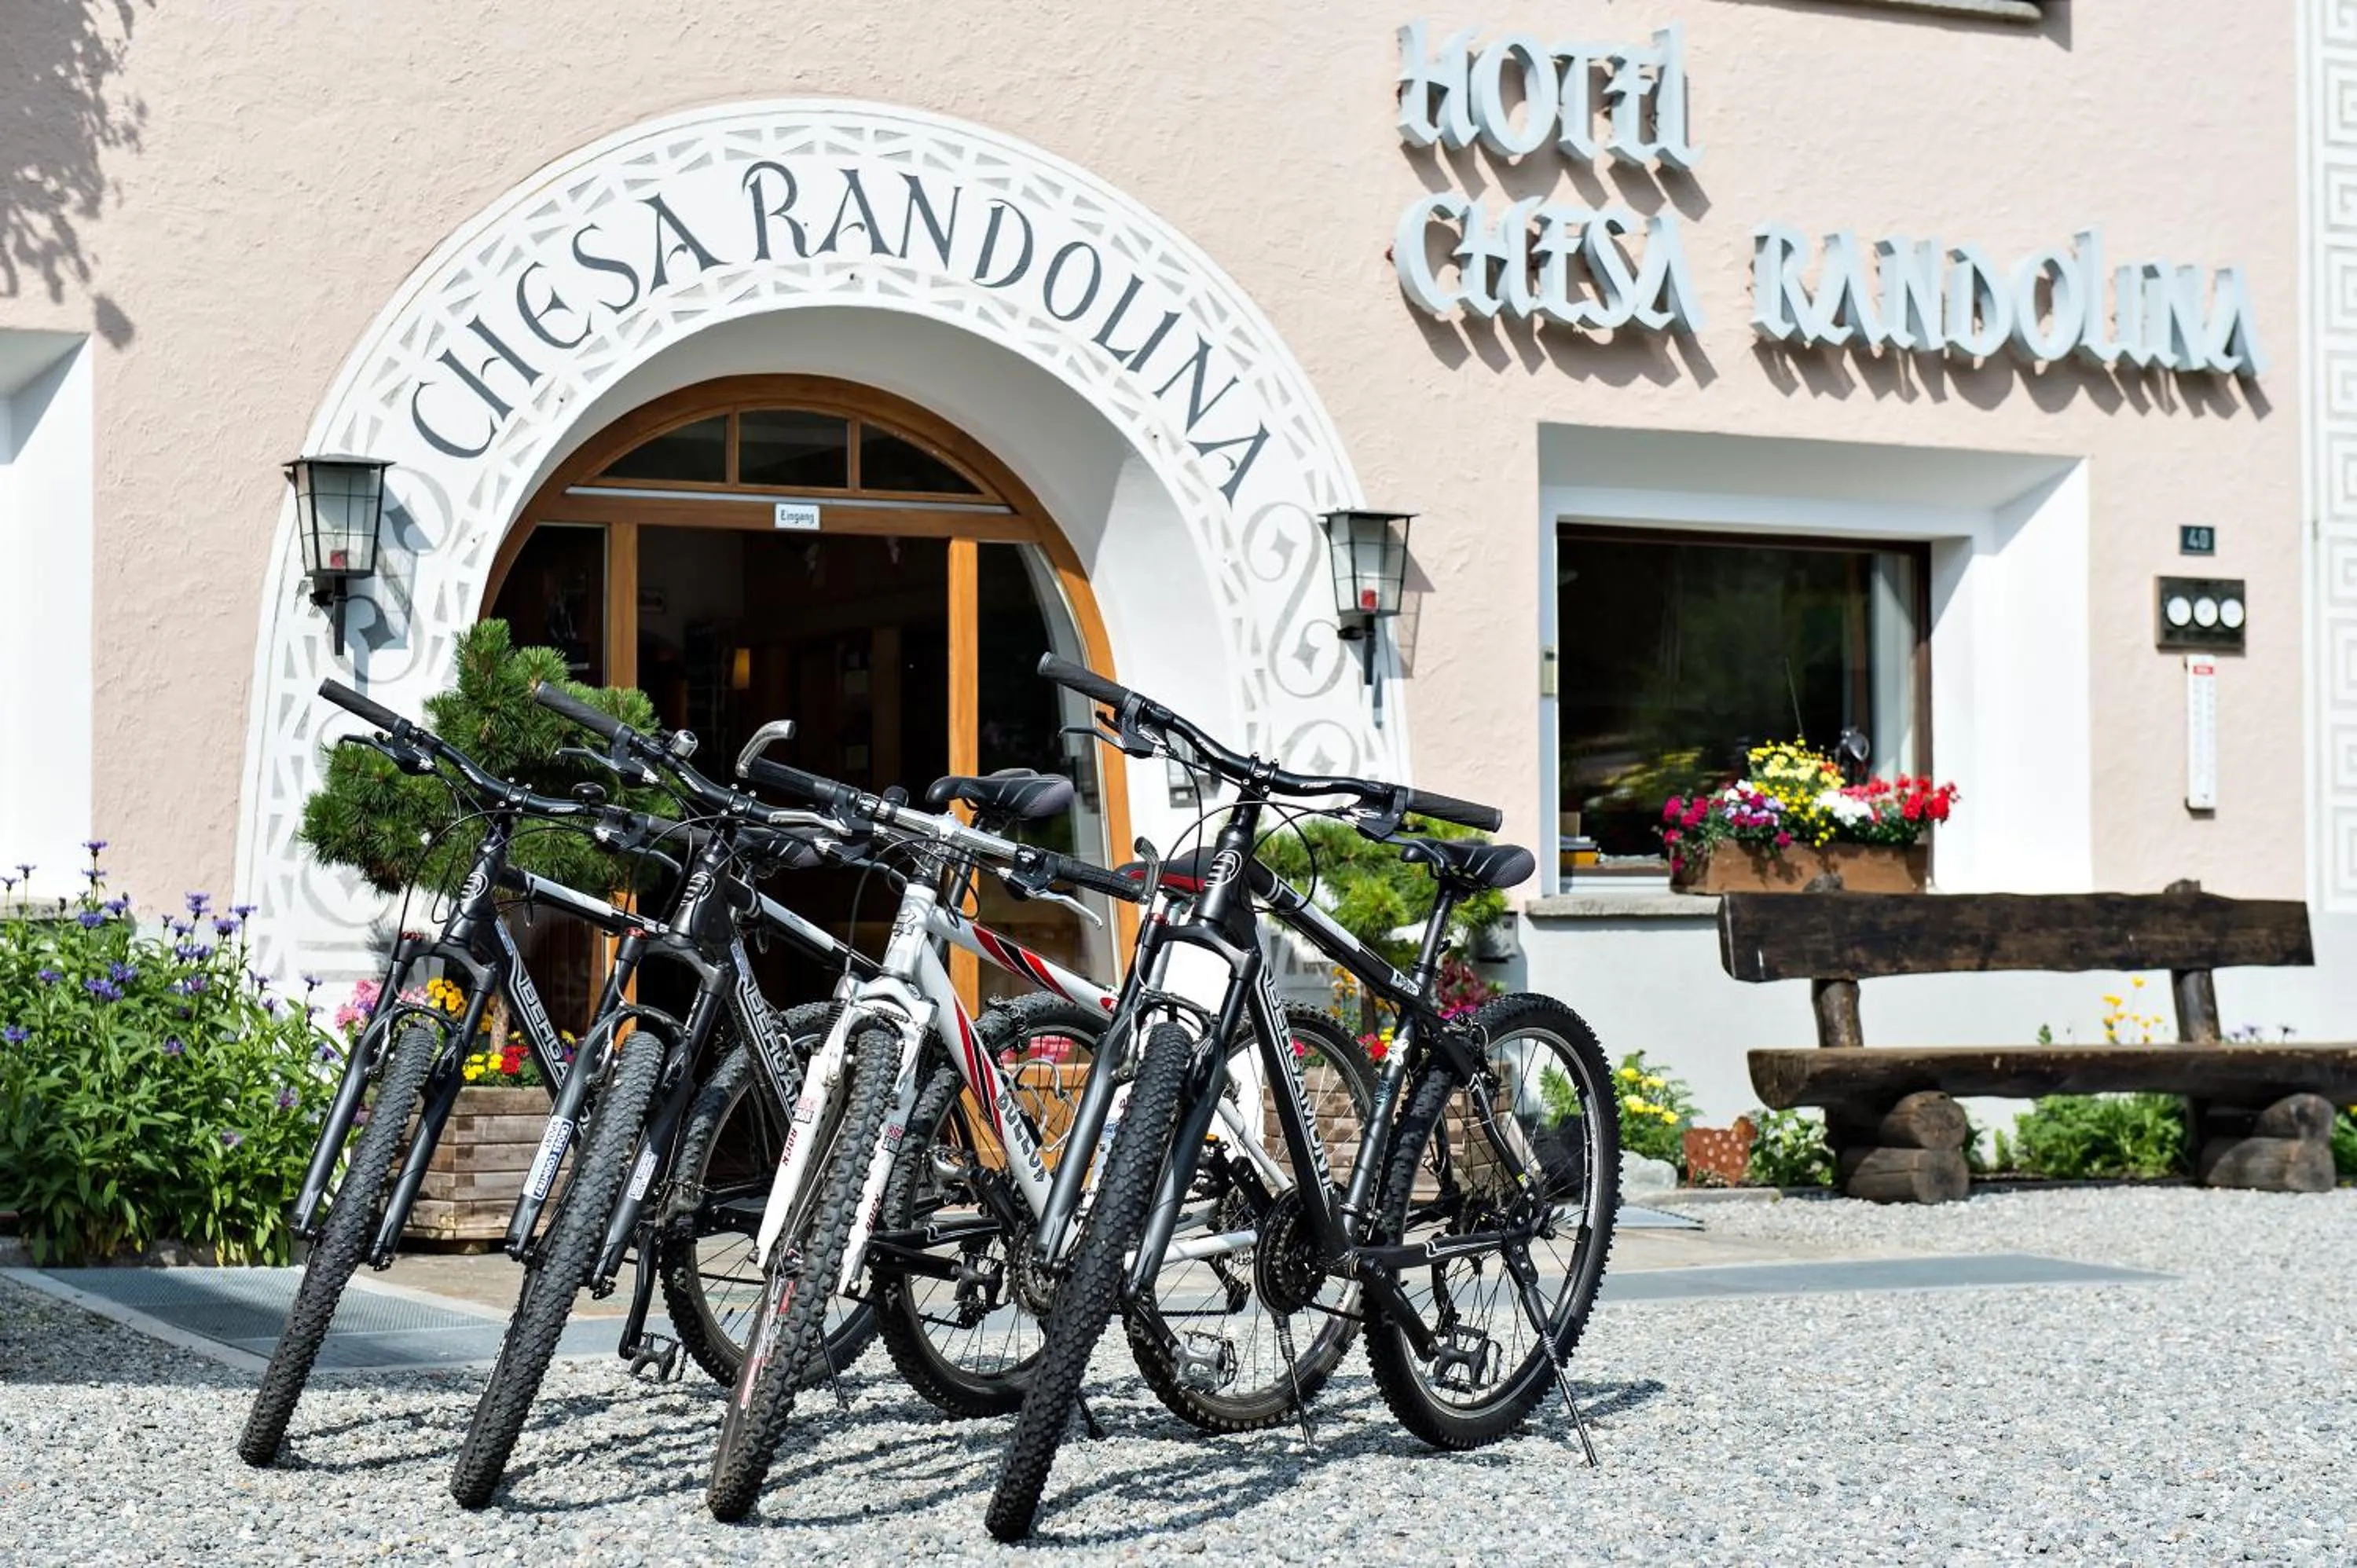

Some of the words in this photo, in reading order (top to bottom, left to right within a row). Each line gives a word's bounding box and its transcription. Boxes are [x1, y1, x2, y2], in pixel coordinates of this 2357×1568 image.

[1396, 18, 1704, 168] HOTEL
[412, 192, 732, 458] CHESA
[742, 161, 1270, 509] RANDOLINA
[1395, 192, 1706, 332] CHESA
[1750, 221, 2270, 378] RANDOLINA
